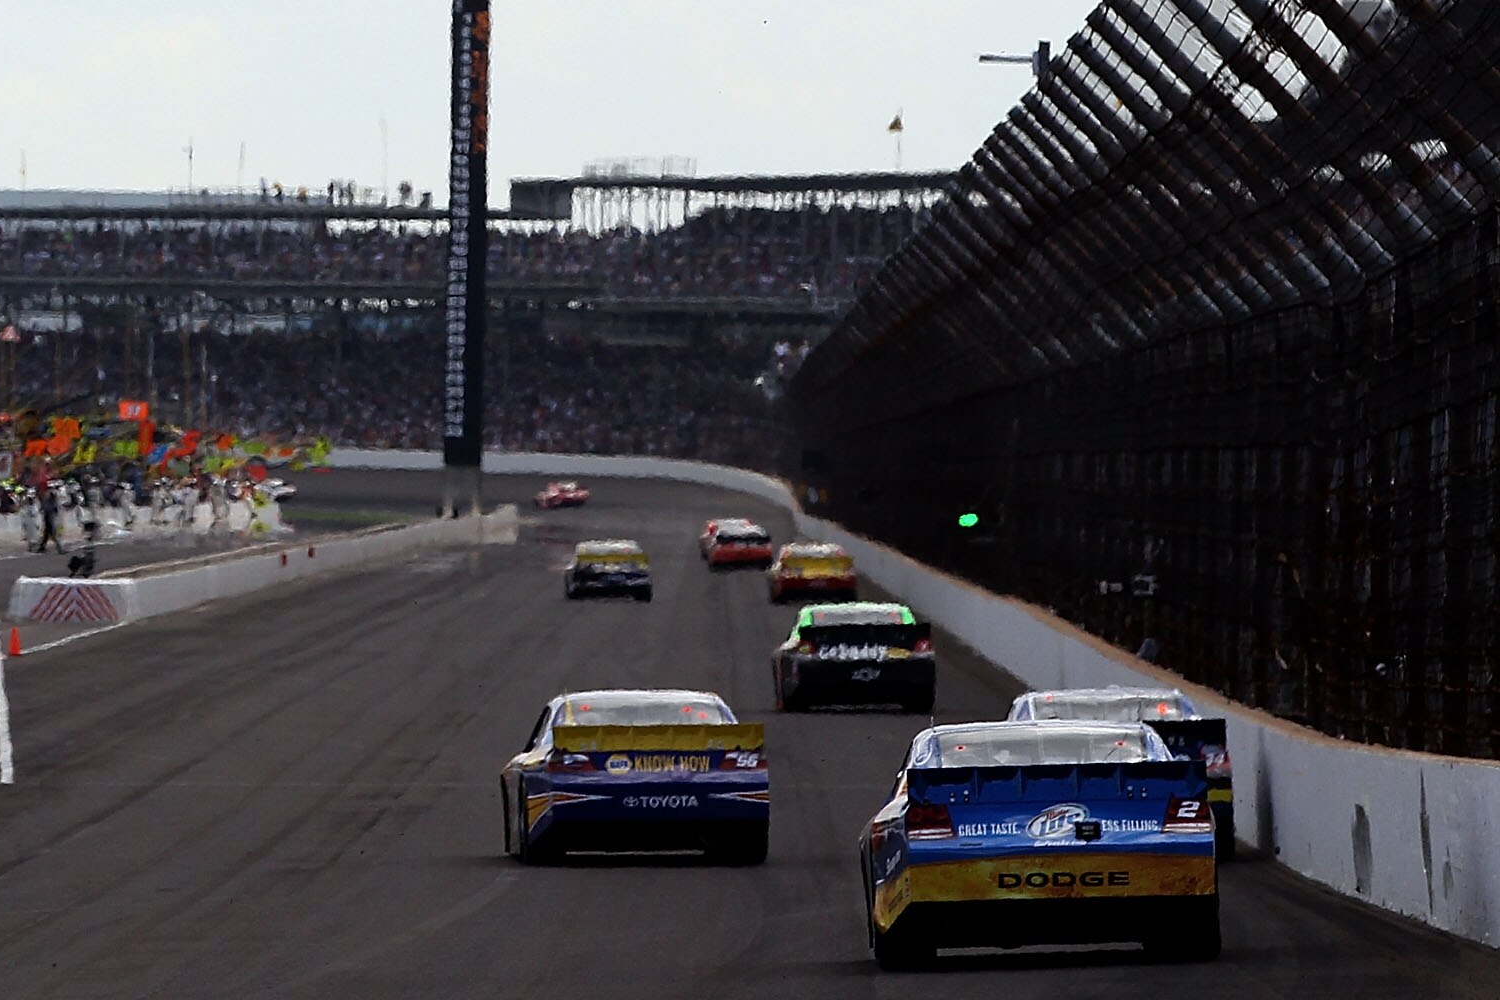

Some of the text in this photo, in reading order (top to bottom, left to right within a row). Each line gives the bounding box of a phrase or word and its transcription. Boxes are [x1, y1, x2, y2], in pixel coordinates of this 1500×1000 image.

[634, 754, 712, 773] KNOW HOW
[735, 753, 761, 768] 56
[640, 794, 700, 809] TOYOTA
[1176, 801, 1201, 818] 2
[958, 822, 1021, 838] GREAT TASTE.
[1101, 819, 1121, 833] ESS
[1122, 817, 1162, 833] FILLING.
[997, 869, 1130, 889] DODGE
